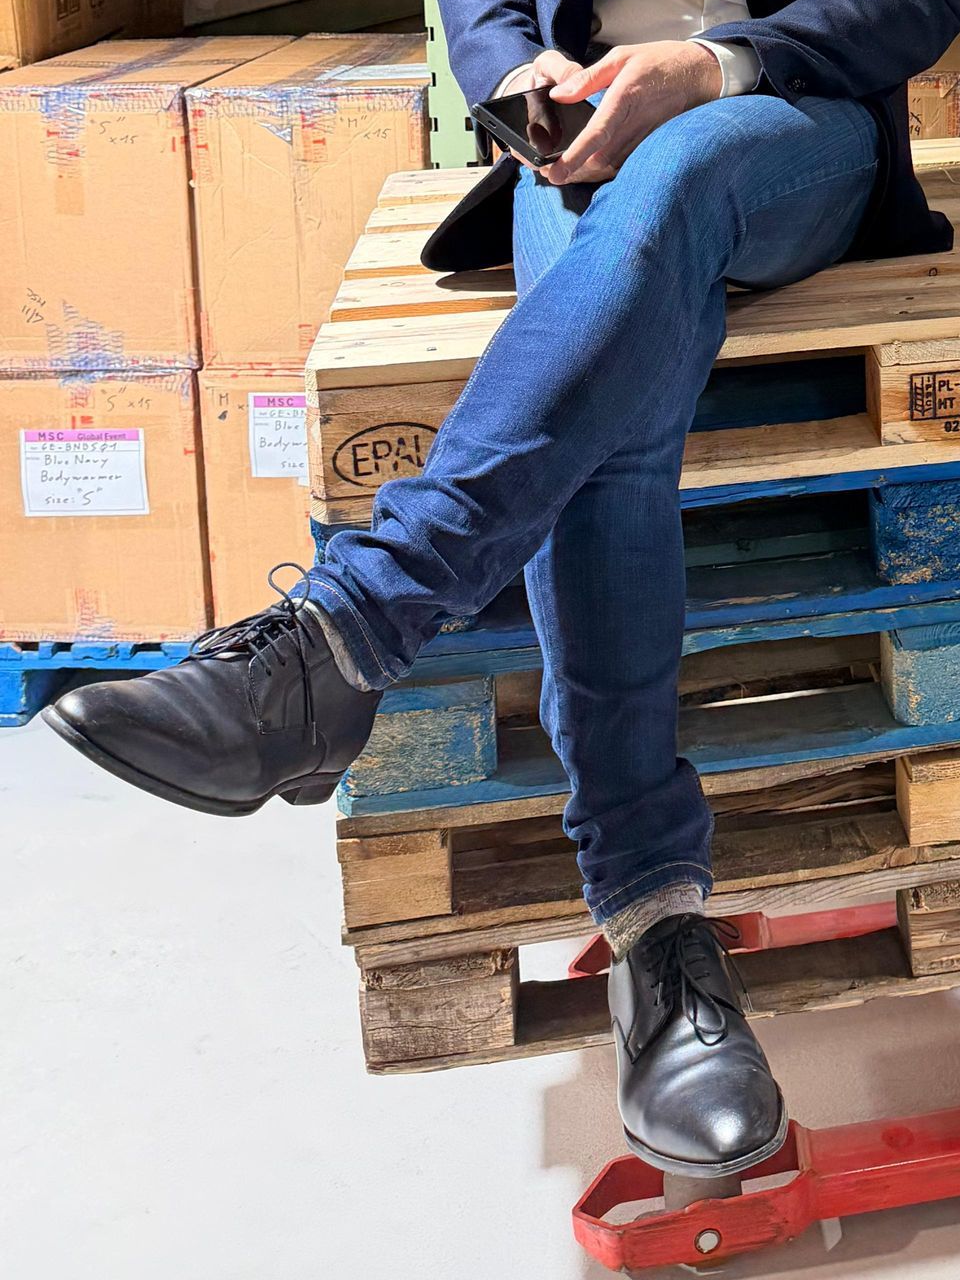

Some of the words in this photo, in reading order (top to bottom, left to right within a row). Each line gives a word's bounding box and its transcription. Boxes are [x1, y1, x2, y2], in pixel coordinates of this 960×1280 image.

[267, 398, 294, 406] MSC
[938, 396, 956, 410] HT
[275, 420, 300, 431] Blue
[38, 432, 64, 441] MSC
[77, 432, 102, 441] Global
[104, 432, 127, 440] Event
[45, 454, 69, 466] Blue
[75, 454, 108, 468] Navy
[41, 470, 122, 486] Bodywarmer
